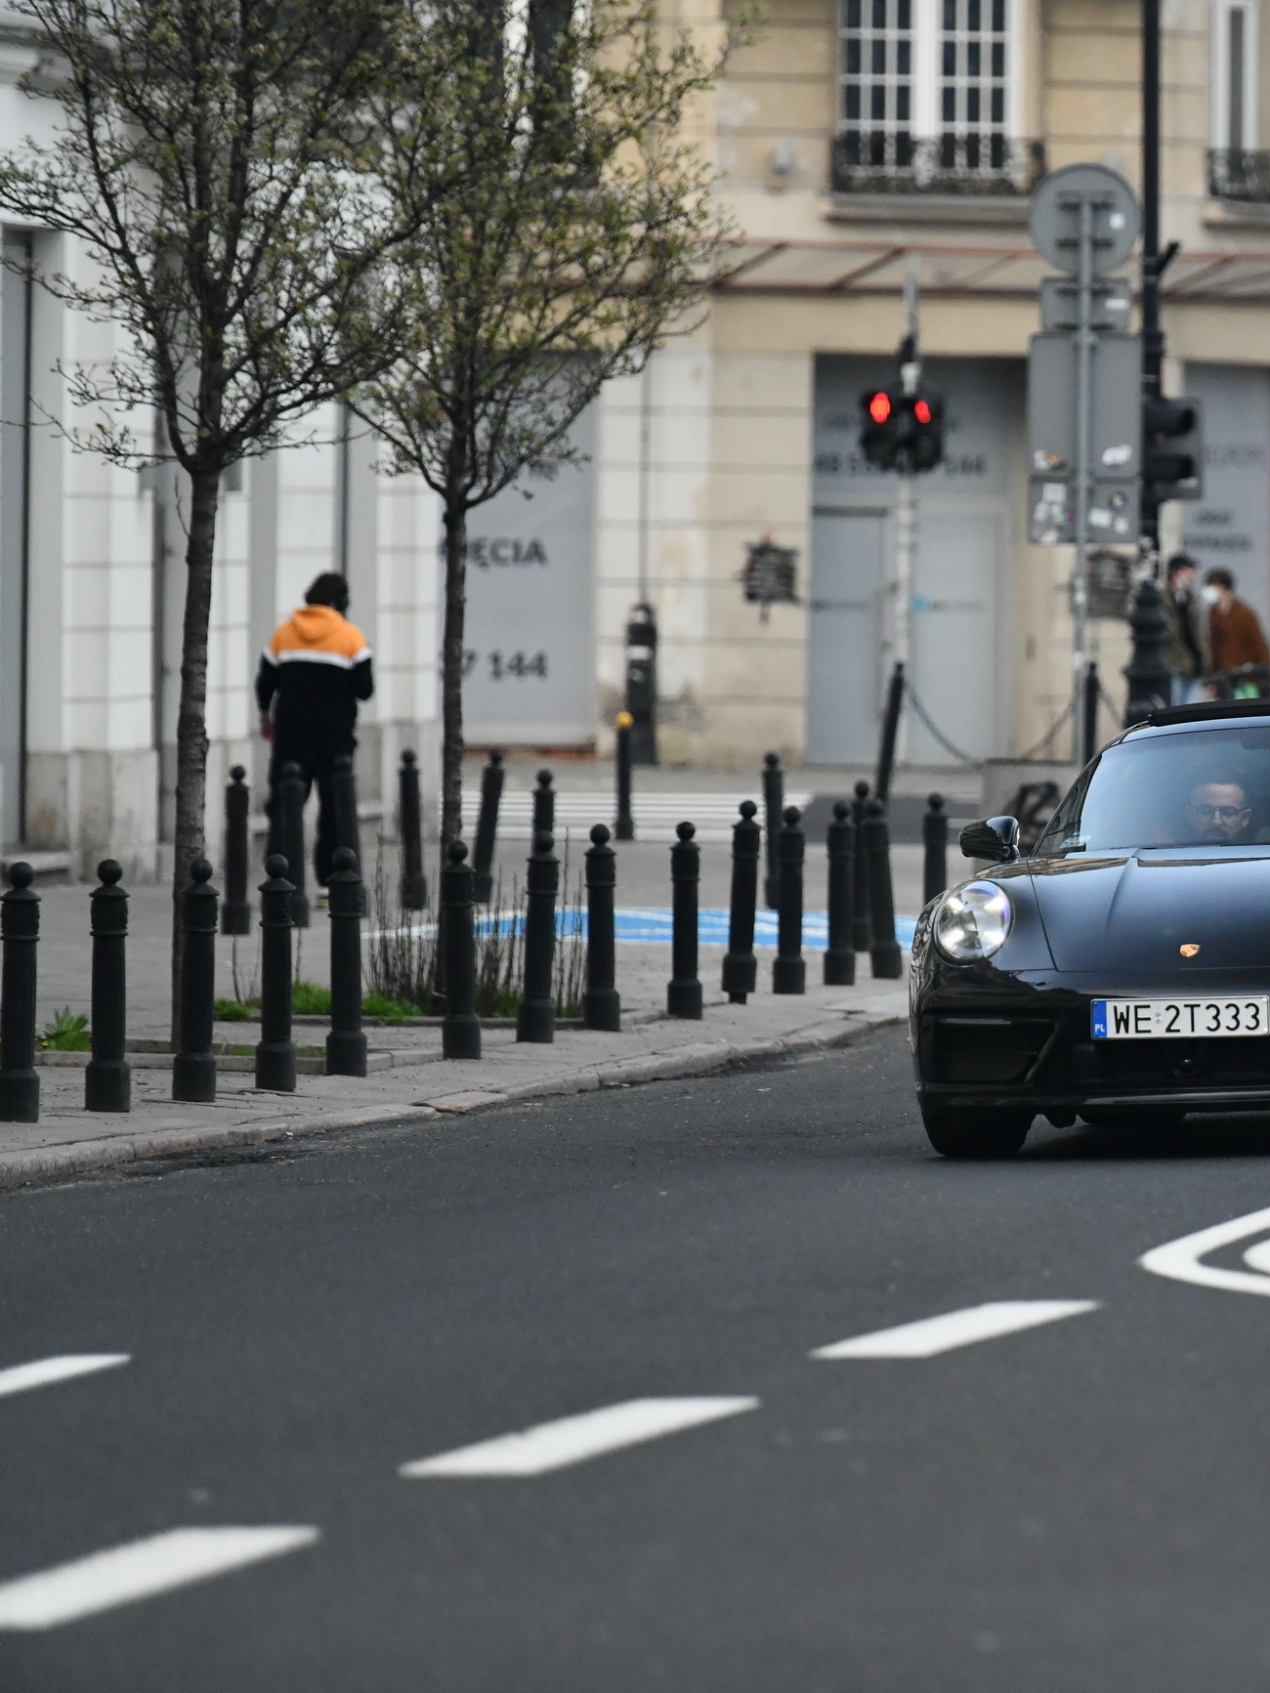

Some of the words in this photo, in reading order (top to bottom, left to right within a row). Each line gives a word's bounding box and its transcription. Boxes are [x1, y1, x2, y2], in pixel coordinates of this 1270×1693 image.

[489, 651, 548, 681] 144
[1095, 1024, 1106, 1033] PL
[1113, 1004, 1152, 1034] WE
[1165, 1002, 1260, 1033] 2T333
